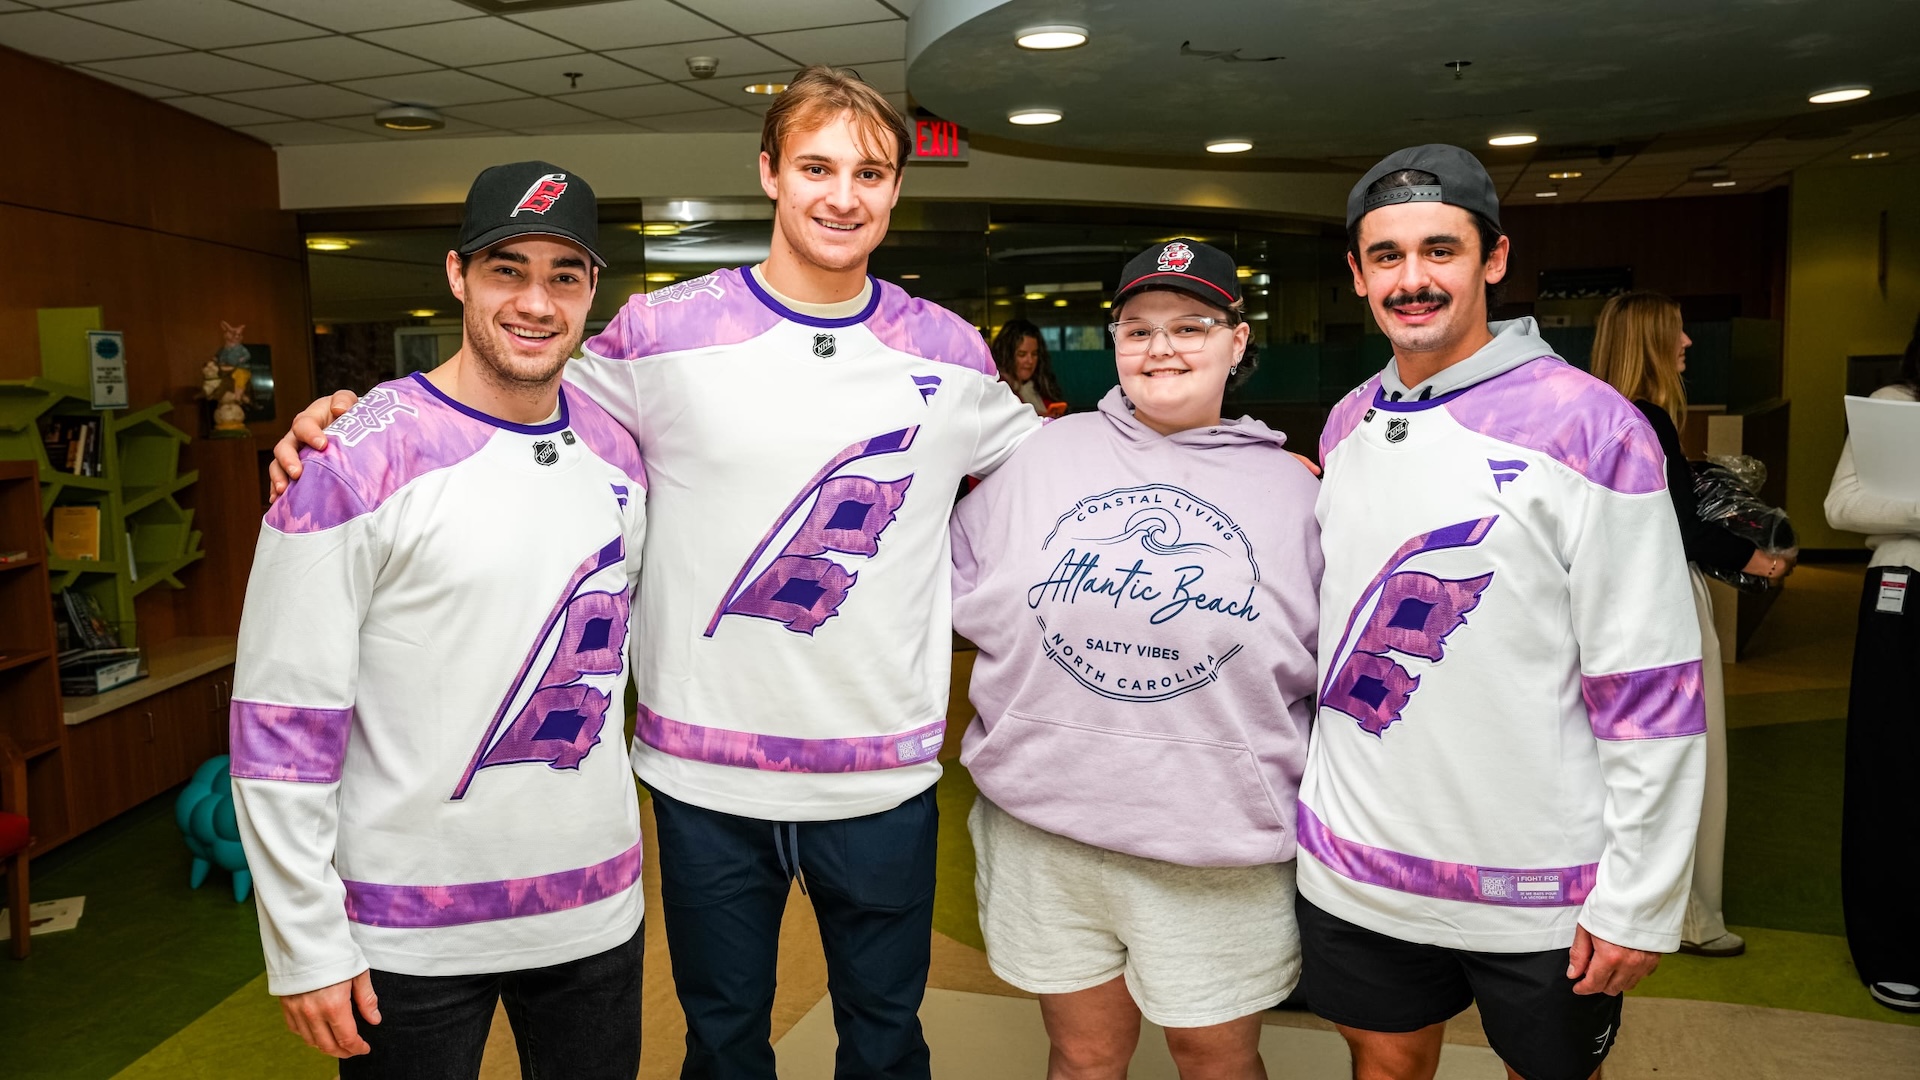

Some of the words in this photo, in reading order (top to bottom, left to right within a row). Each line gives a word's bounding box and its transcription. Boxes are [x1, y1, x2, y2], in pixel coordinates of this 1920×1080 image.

[916, 121, 959, 157] EXIT
[817, 339, 833, 354] NHL
[1389, 424, 1406, 438] NHL
[539, 446, 554, 461] NHL
[1077, 494, 1162, 522] COASTAL
[1174, 499, 1233, 541] LIVING
[1028, 548, 1162, 609] Atlantic
[1150, 565, 1260, 624] Beach
[1052, 633, 1106, 683] NORTH
[1117, 654, 1215, 691] CAROLINA
[1086, 638, 1132, 655] SALTY
[1137, 644, 1180, 661] VIBES
